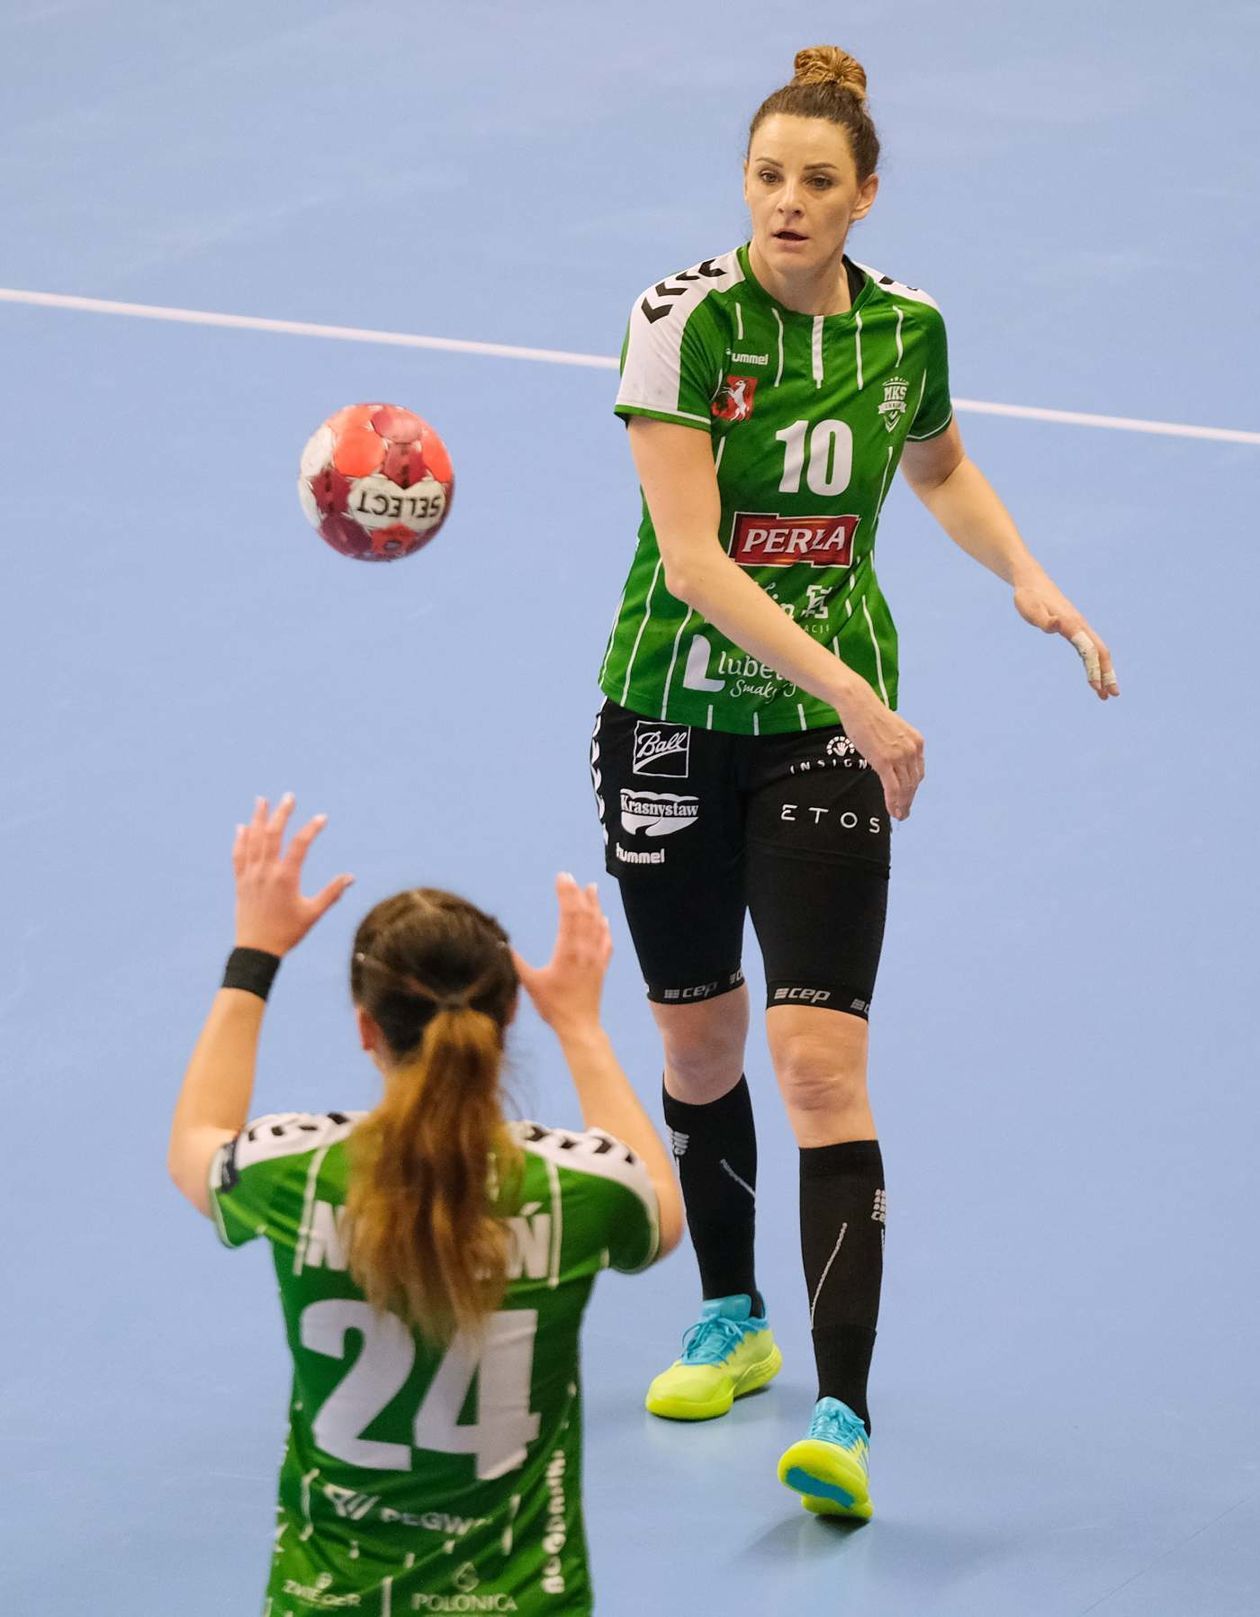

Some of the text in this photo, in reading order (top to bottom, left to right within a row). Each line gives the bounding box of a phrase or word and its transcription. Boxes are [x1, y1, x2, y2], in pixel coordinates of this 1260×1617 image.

[884, 386, 908, 402] MKS
[775, 418, 853, 497] 10
[356, 490, 442, 519] SELECT
[741, 525, 846, 554] PERŁA
[637, 731, 689, 758] Ball
[789, 758, 869, 775] INSIGN
[620, 794, 700, 818] Krasnystaw
[780, 803, 881, 834] ETOS
[615, 841, 666, 865] hummel
[682, 980, 719, 998] cep
[788, 986, 832, 1004] cep
[299, 1298, 541, 1482] 24
[410, 1592, 518, 1612] POLONICA
